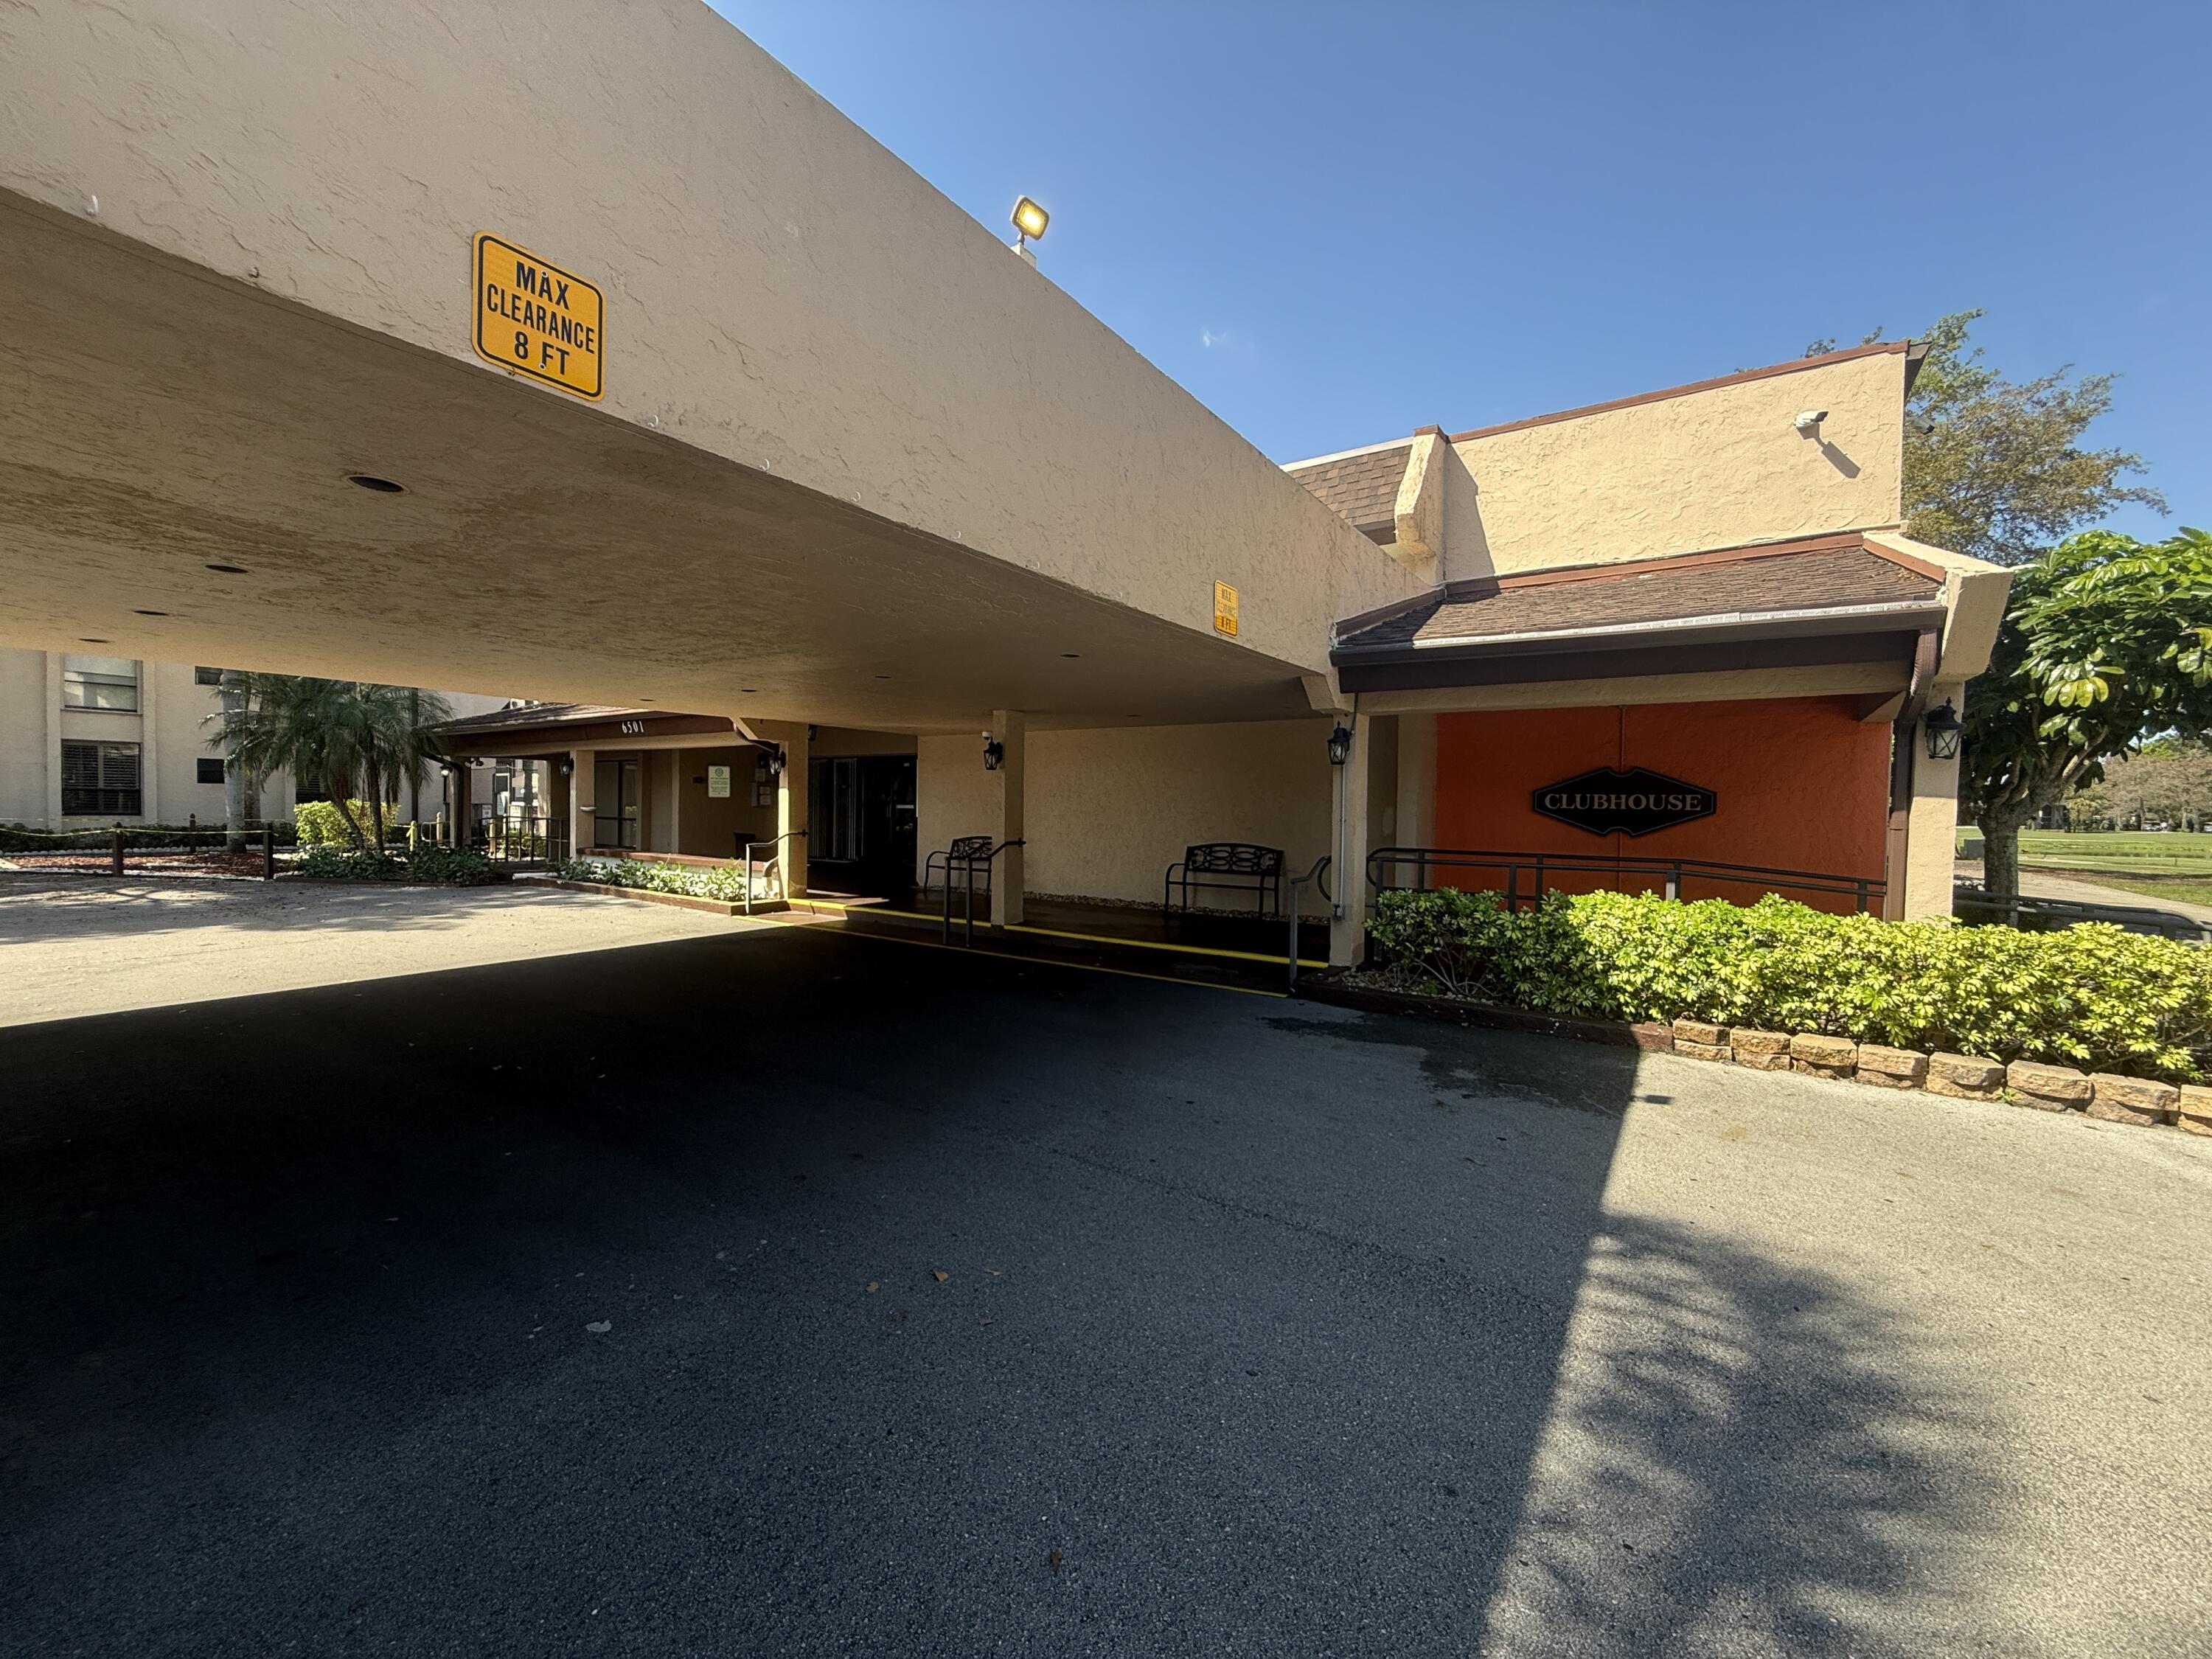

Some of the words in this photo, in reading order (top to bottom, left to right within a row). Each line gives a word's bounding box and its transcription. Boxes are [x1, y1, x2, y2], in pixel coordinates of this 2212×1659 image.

[516, 260, 569, 310] MAX
[487, 283, 595, 355] CLEARANCE
[514, 330, 529, 360] 8
[542, 341, 570, 375] FT
[622, 720, 644, 734] 6501
[1545, 793, 1702, 811] CLUBHOUSE
